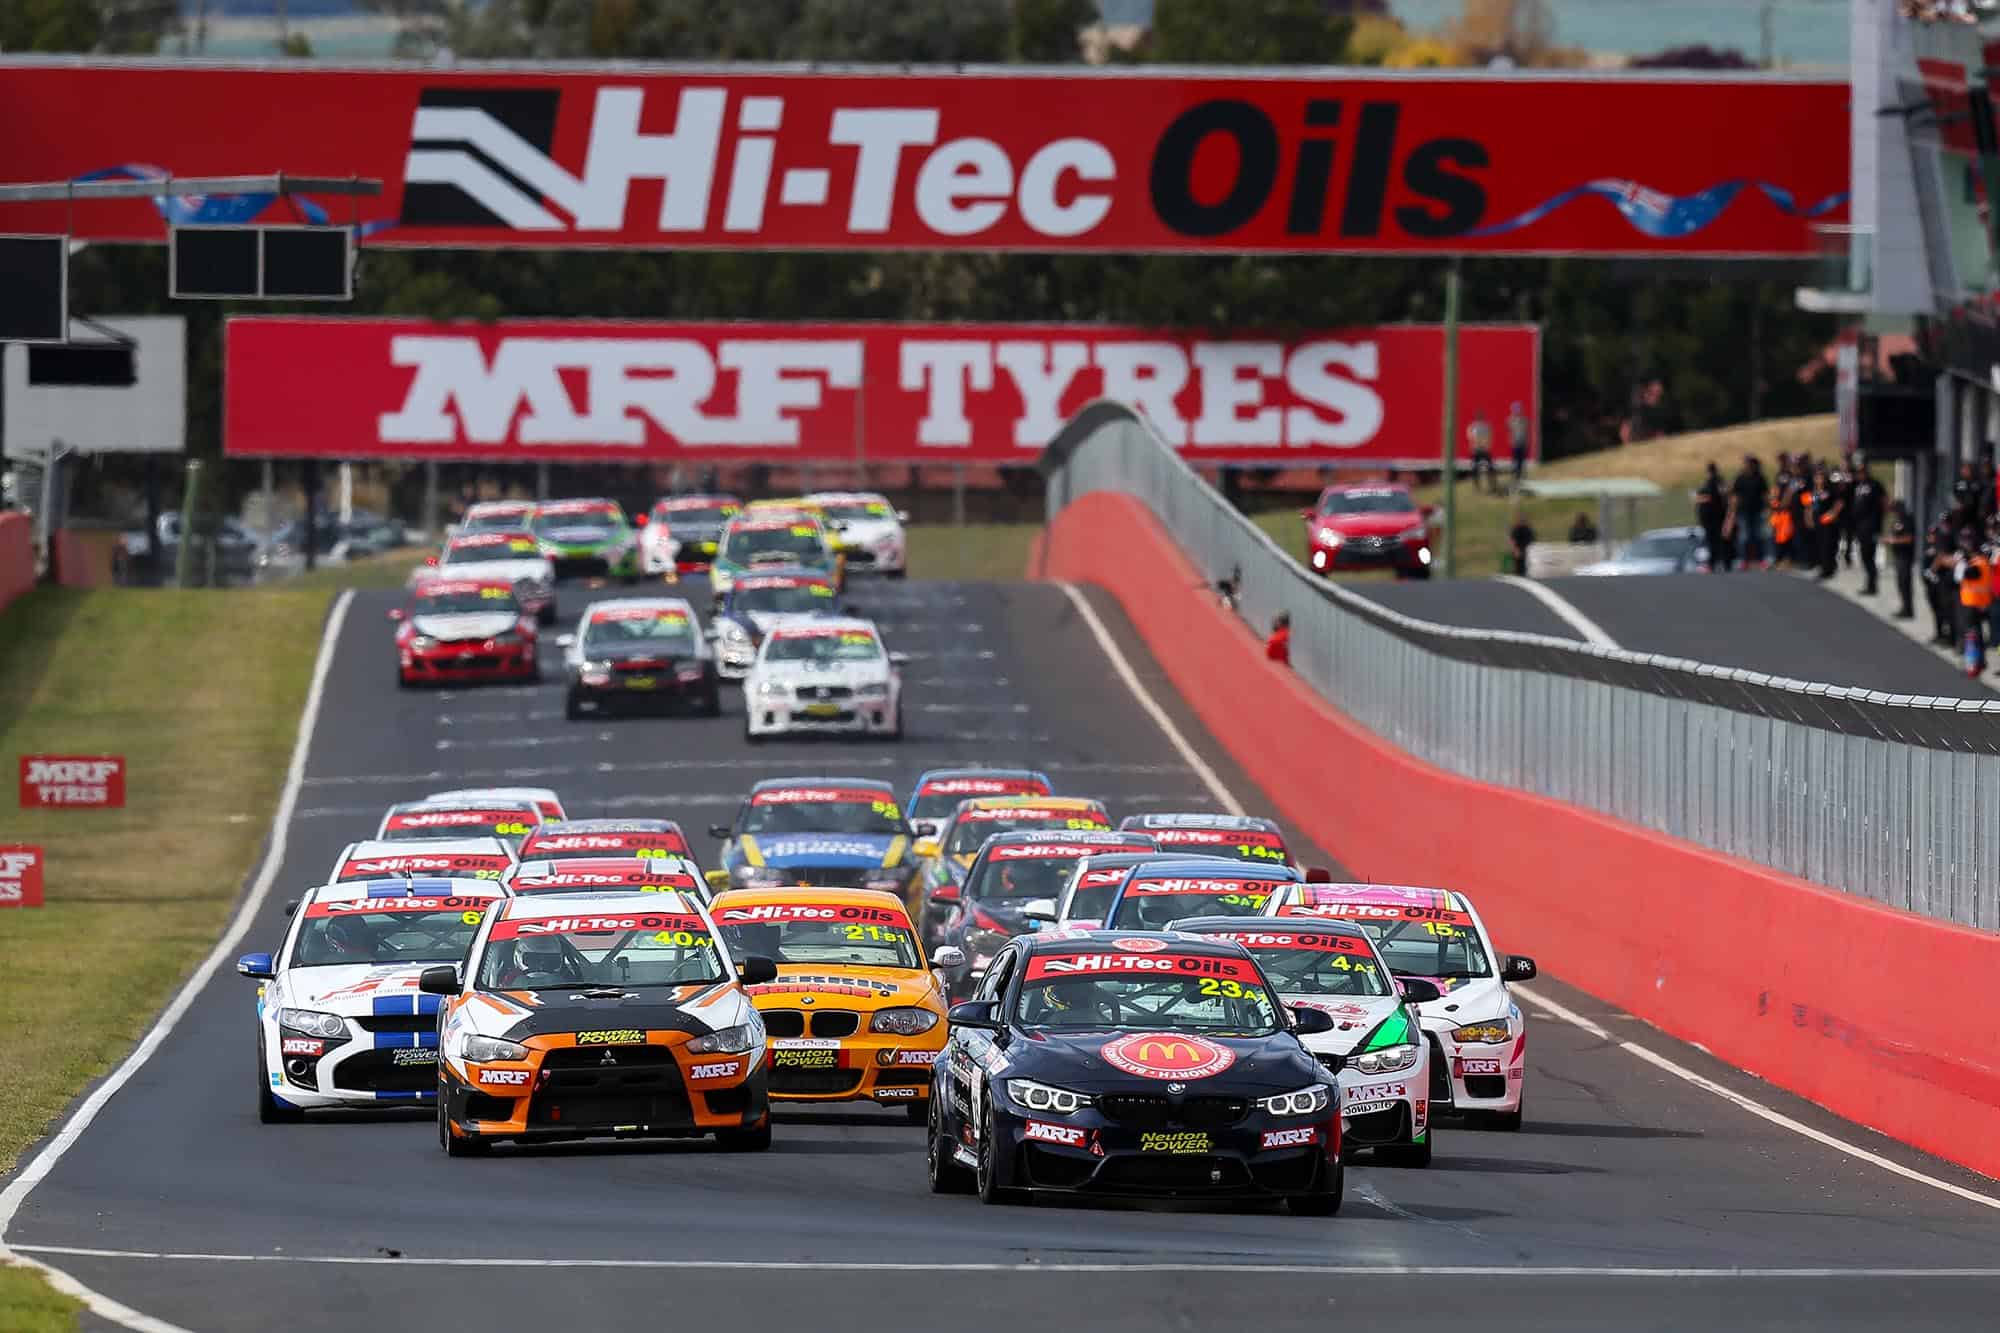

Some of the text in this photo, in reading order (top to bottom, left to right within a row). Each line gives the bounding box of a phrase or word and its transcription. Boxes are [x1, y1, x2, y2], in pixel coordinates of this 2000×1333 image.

[573, 86, 1490, 240] Hi-Tec Oils
[378, 336, 1385, 449] MRF TYRES
[25, 761, 119, 784] MRF
[38, 784, 108, 803] TYRES
[417, 813, 483, 825] Hi-Tec
[553, 836, 622, 849] Hi-Tec
[1156, 831, 1222, 843] Hi-Tec
[1023, 844, 1093, 857] Hi-Tec
[379, 857, 498, 871] Hi-Tec Oils
[547, 874, 677, 885] Hi-Tec Oils
[1164, 879, 1239, 892] Hi-Tec
[355, 898, 438, 911] Hi-Tec
[751, 905, 894, 923] Hi-Tec Oils
[1317, 904, 1458, 922] Hi-Tec Oils
[546, 917, 698, 932] Hi-Tec Oils
[1297, 935, 1355, 951] Oils
[1076, 955, 1240, 976] Hi-Tec Oils
[777, 975, 900, 993] ERKIN
[283, 1039, 323, 1053] MRF
[579, 1034, 642, 1045] POWER
[775, 1048, 833, 1059] Neuton
[899, 1051, 939, 1064] MRF
[776, 1056, 835, 1067] POWER
[479, 1070, 530, 1085] MRF
[690, 1062, 740, 1080] MRF
[878, 1088, 915, 1097] DAYCO
[1349, 1083, 1405, 1101] MRF
[1027, 1121, 1085, 1144] MRF
[1140, 1131, 1209, 1143] Neuton
[1263, 1127, 1316, 1148] MRF
[1142, 1139, 1209, 1151] POWER
